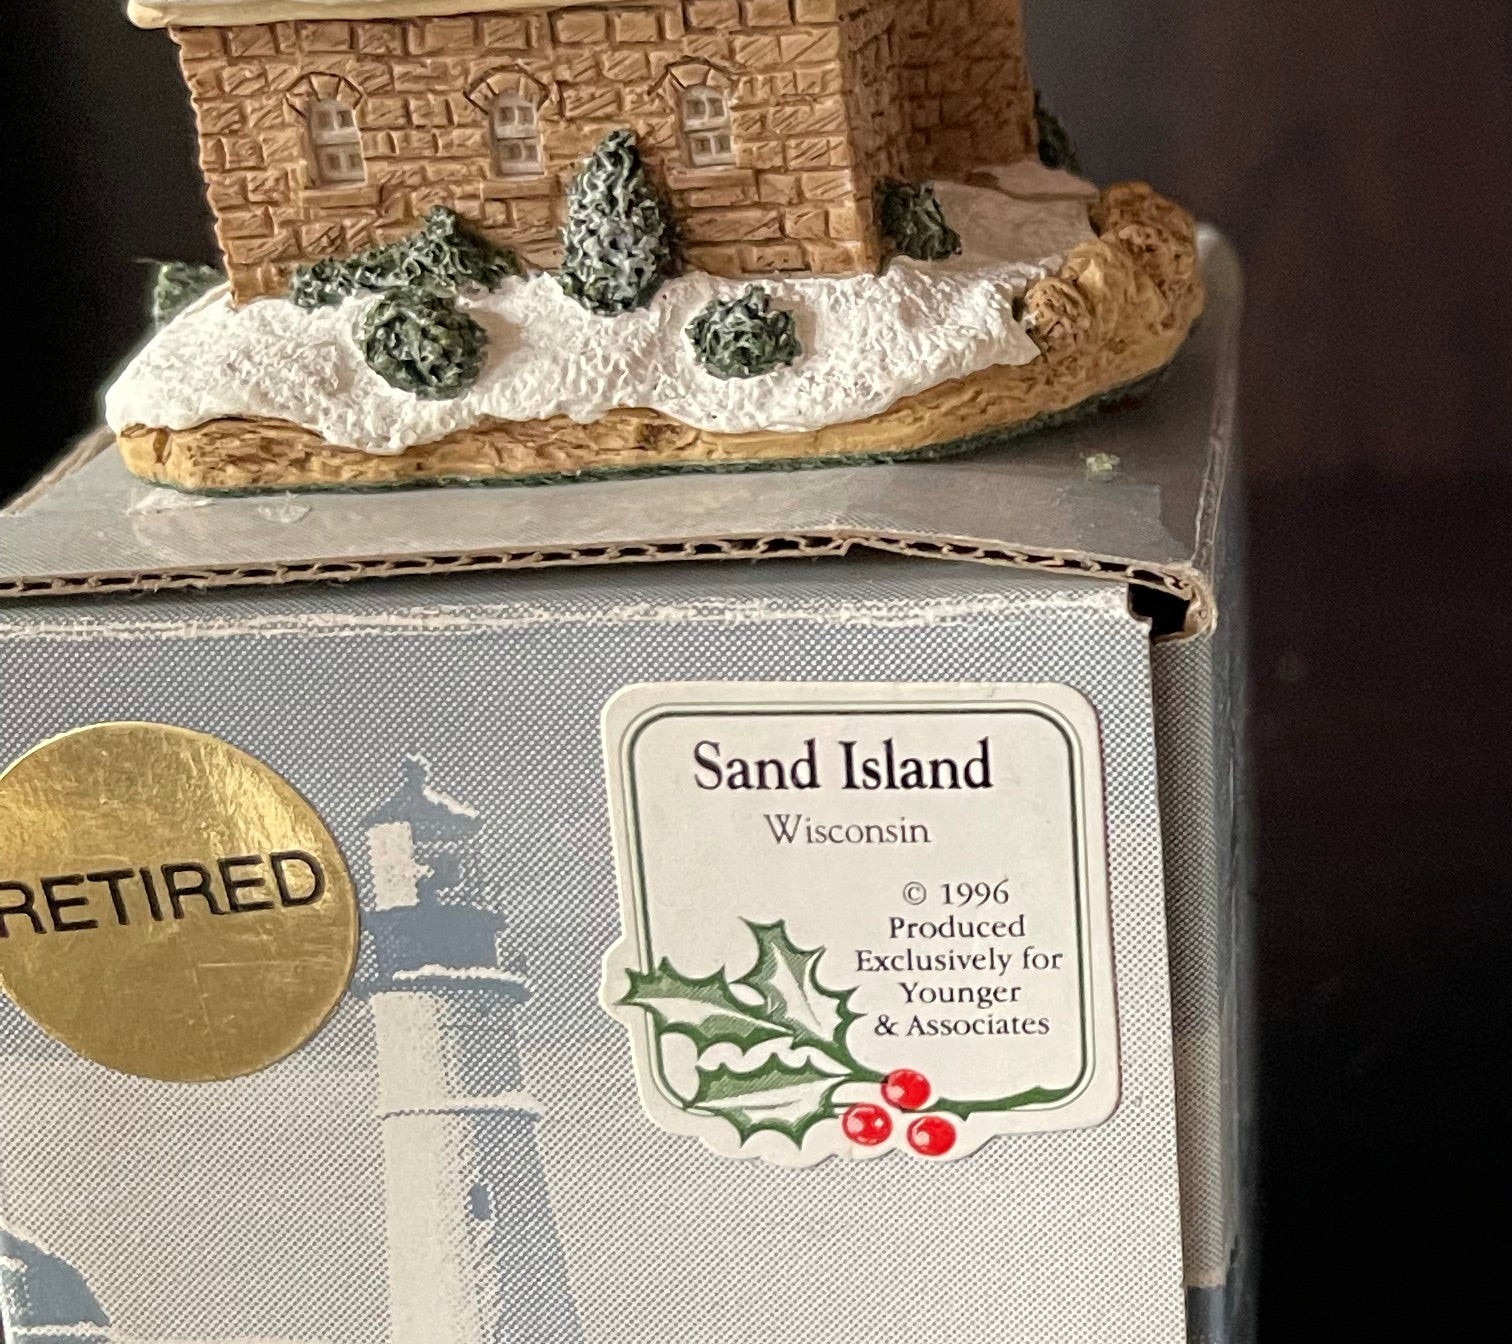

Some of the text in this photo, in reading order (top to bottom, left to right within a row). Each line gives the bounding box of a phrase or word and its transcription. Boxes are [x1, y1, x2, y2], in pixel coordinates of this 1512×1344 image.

[693, 736, 994, 791] Sand Island
[764, 813, 931, 844] Wisconsin
[0, 849, 326, 938] RETIRED
[941, 879, 1009, 906] 1996
[889, 914, 1026, 938] Produced
[856, 947, 1063, 976] Exclusively for
[900, 983, 1021, 1009] Younger
[874, 1014, 1050, 1036] & Associates
